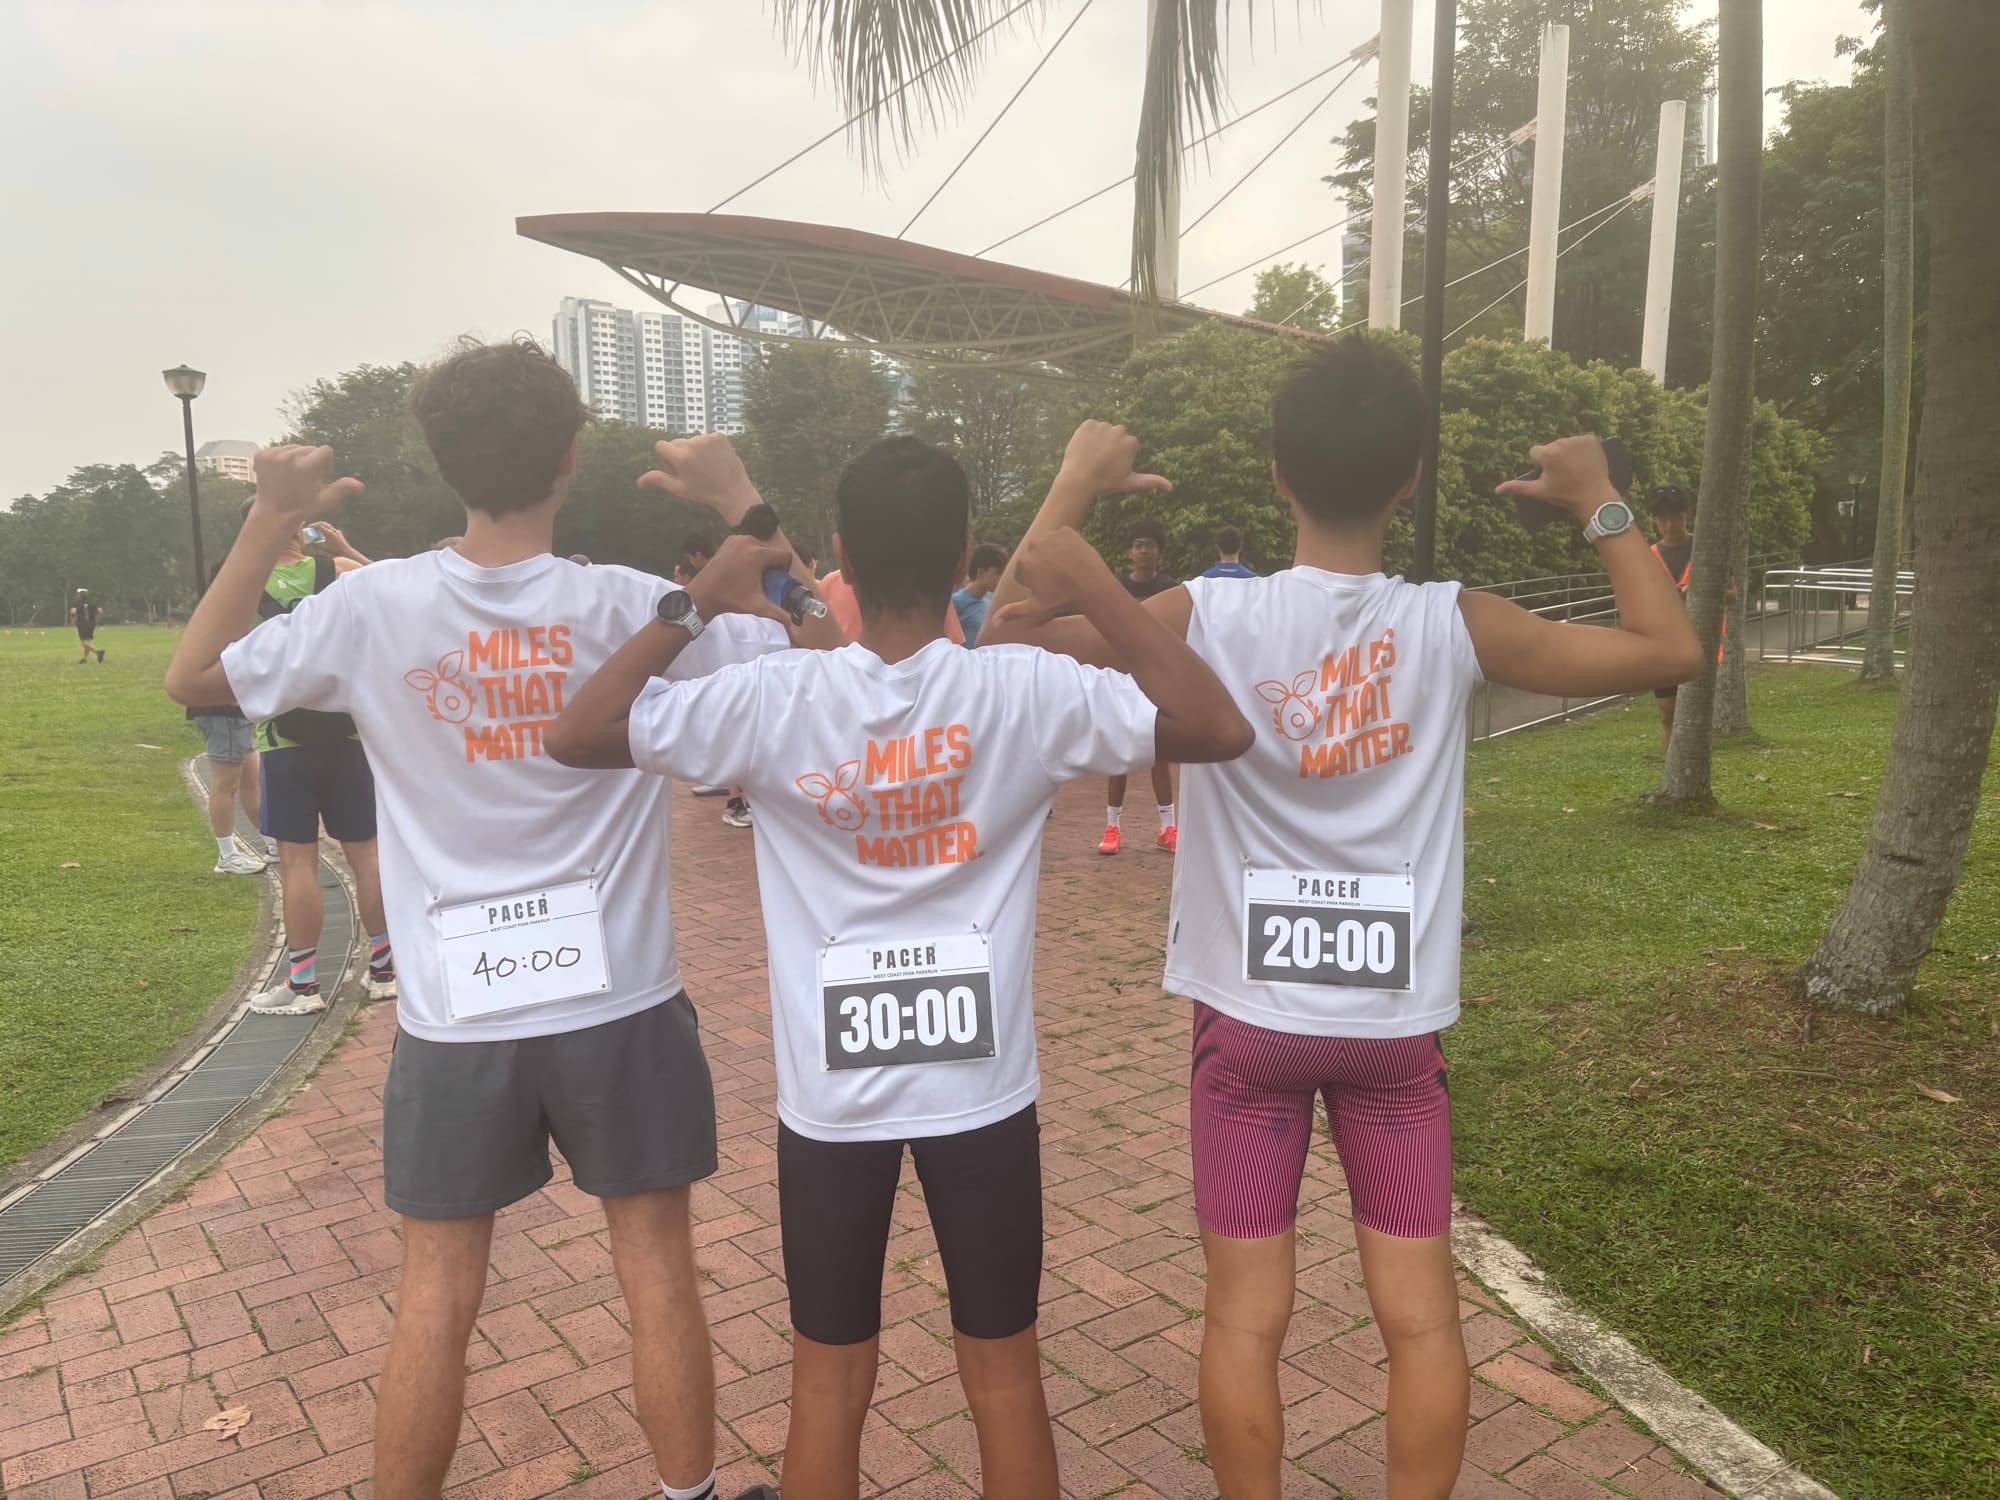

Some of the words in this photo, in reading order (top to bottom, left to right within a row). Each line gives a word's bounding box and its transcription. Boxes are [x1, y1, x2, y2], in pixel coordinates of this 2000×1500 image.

[468, 624, 573, 672] MILES
[1320, 628, 1396, 692] MILES
[478, 671, 568, 719] THAT
[1326, 675, 1392, 737] THAT
[864, 724, 972, 785] MILES
[1300, 722, 1414, 778] MATTER.
[872, 775, 964, 831] THAT
[856, 821, 984, 867] MATTER.
[488, 898, 549, 924] PACER
[1298, 878, 1360, 898] PACER
[472, 946, 581, 986] 40:00
[872, 946, 936, 970] PACER
[1263, 915, 1395, 974] 20:00
[839, 985, 978, 1053] 30:00
